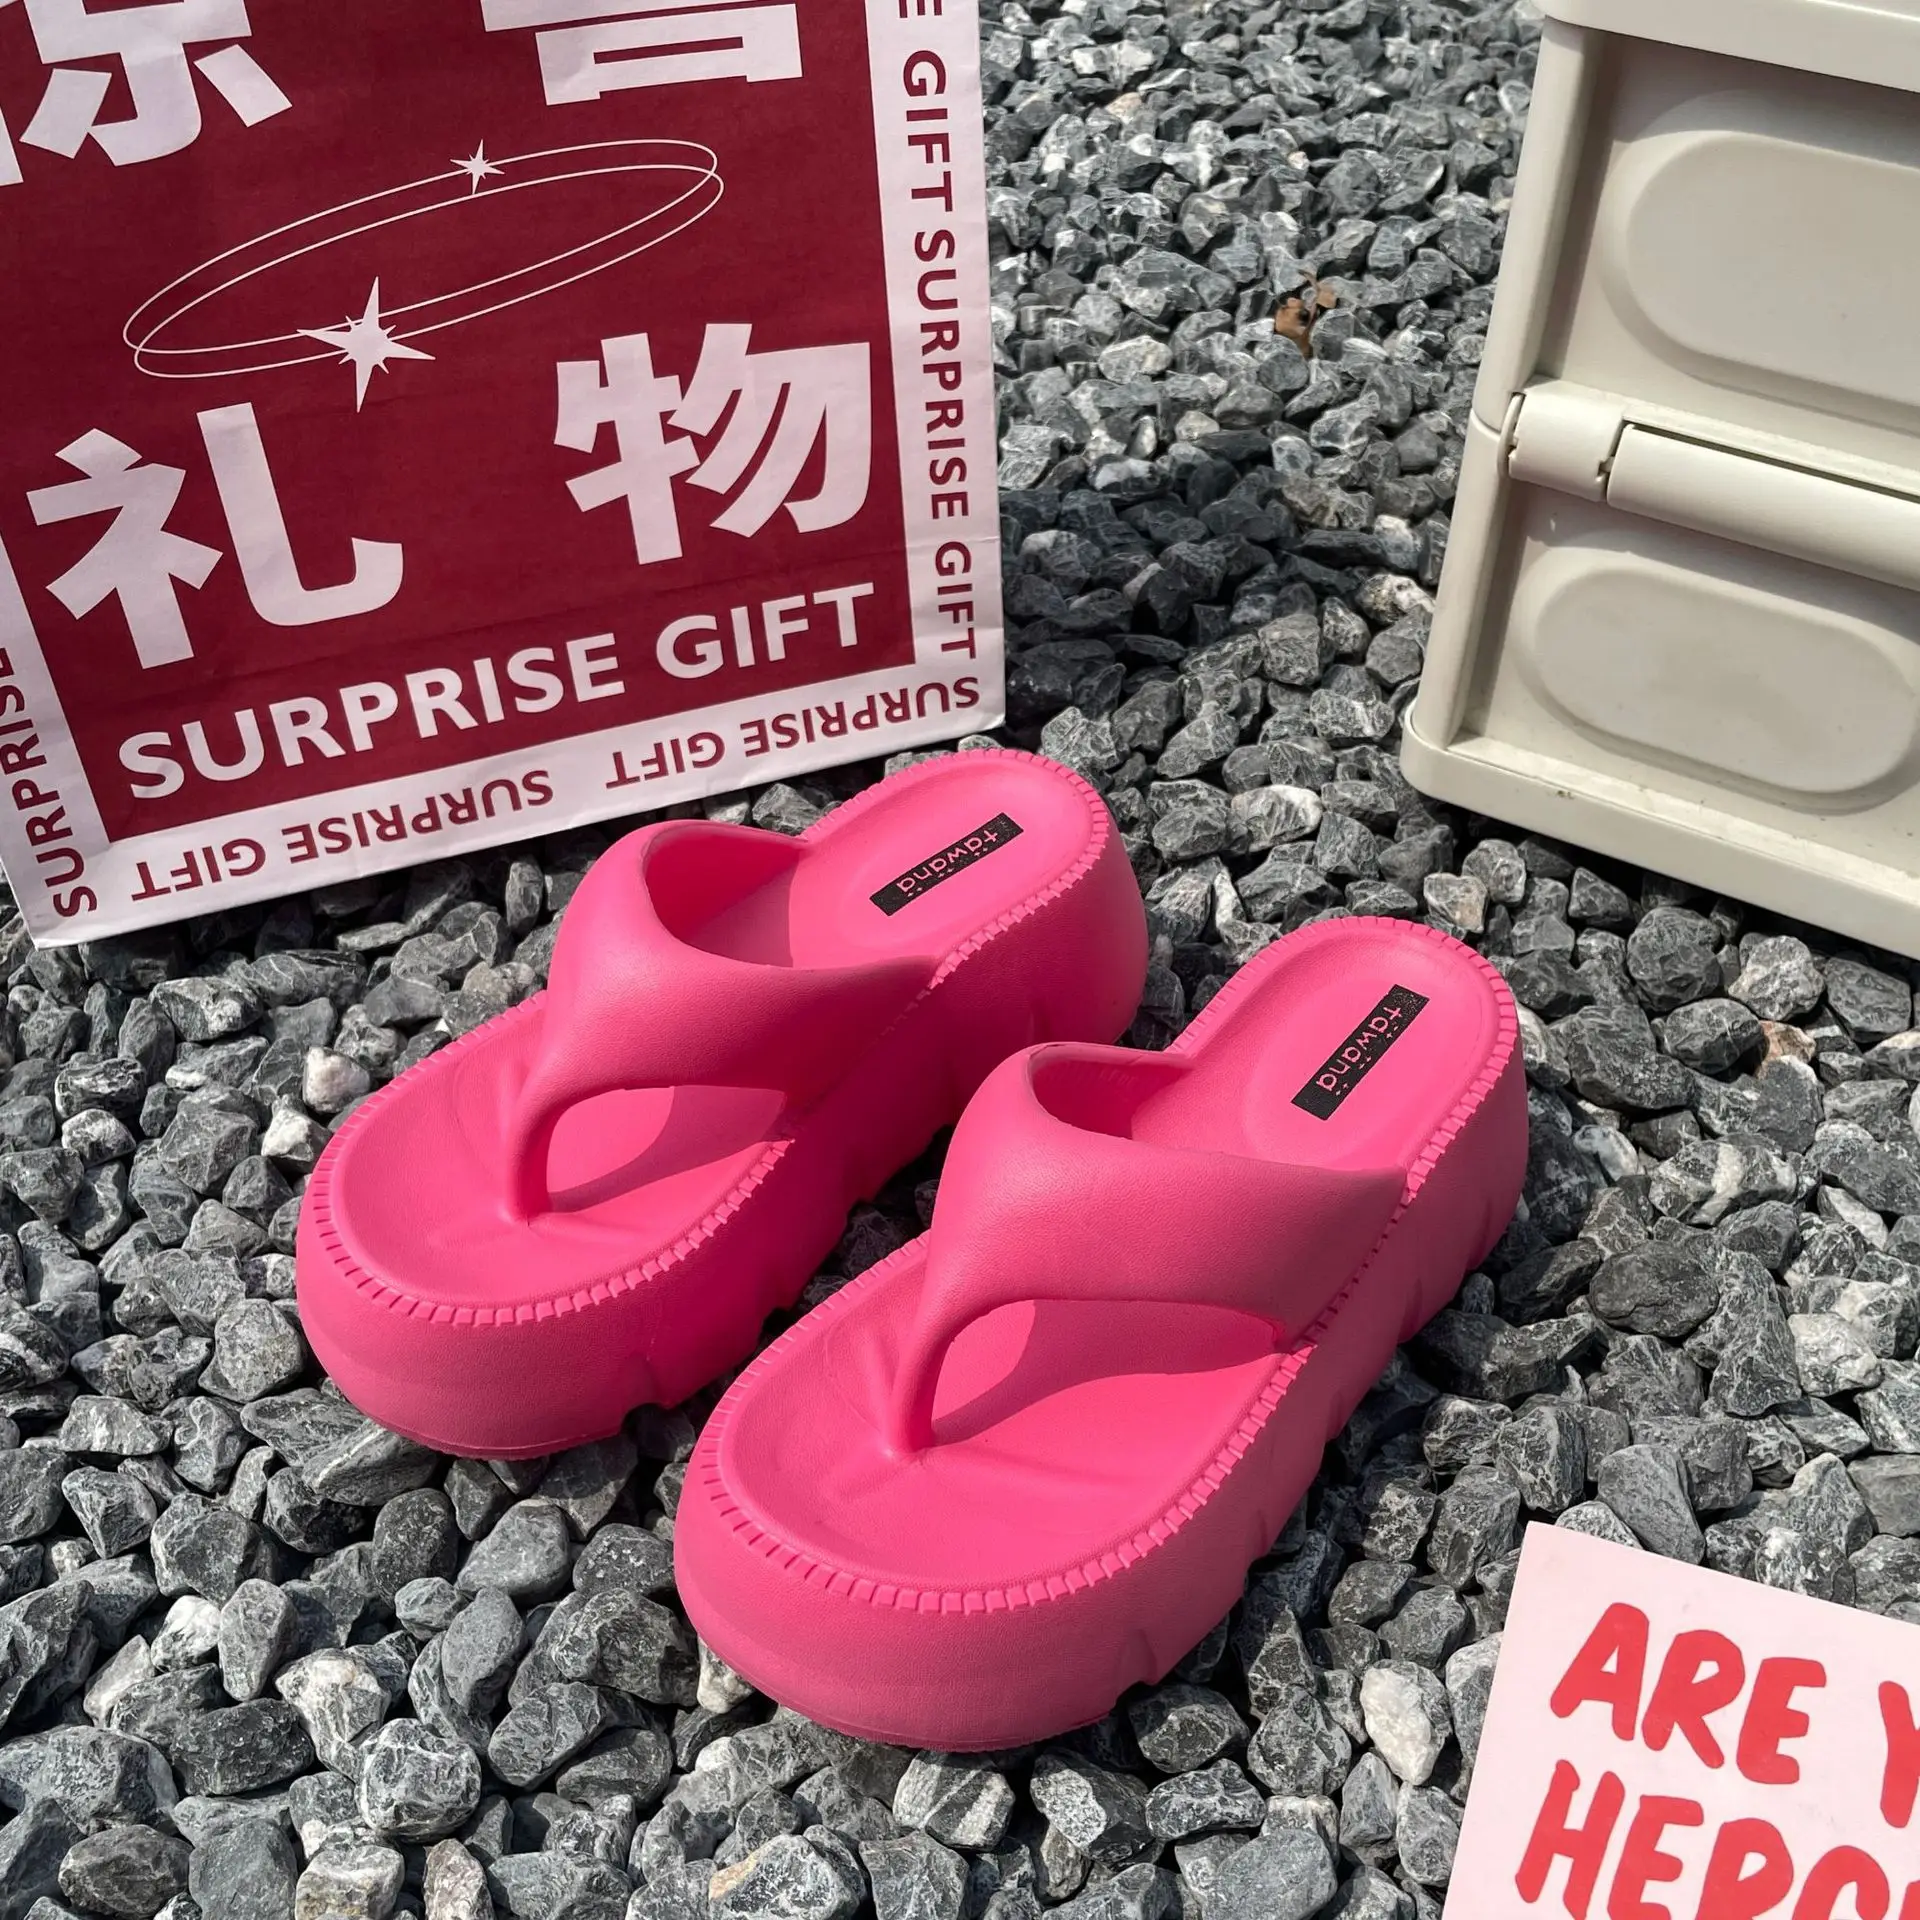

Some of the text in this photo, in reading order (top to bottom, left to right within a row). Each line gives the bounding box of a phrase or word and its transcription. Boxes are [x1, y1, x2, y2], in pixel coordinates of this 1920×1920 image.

[903, 50, 953, 212] GIFT
[914, 230, 969, 519] SURPRISE
[118, 582, 874, 799] SURPRISE GIFT
[934, 541, 976, 659] GIFT
[131, 676, 980, 901] SURPRISE GIFT SURPRISE GIFT
[1550, 1602, 1827, 1785] ARE
